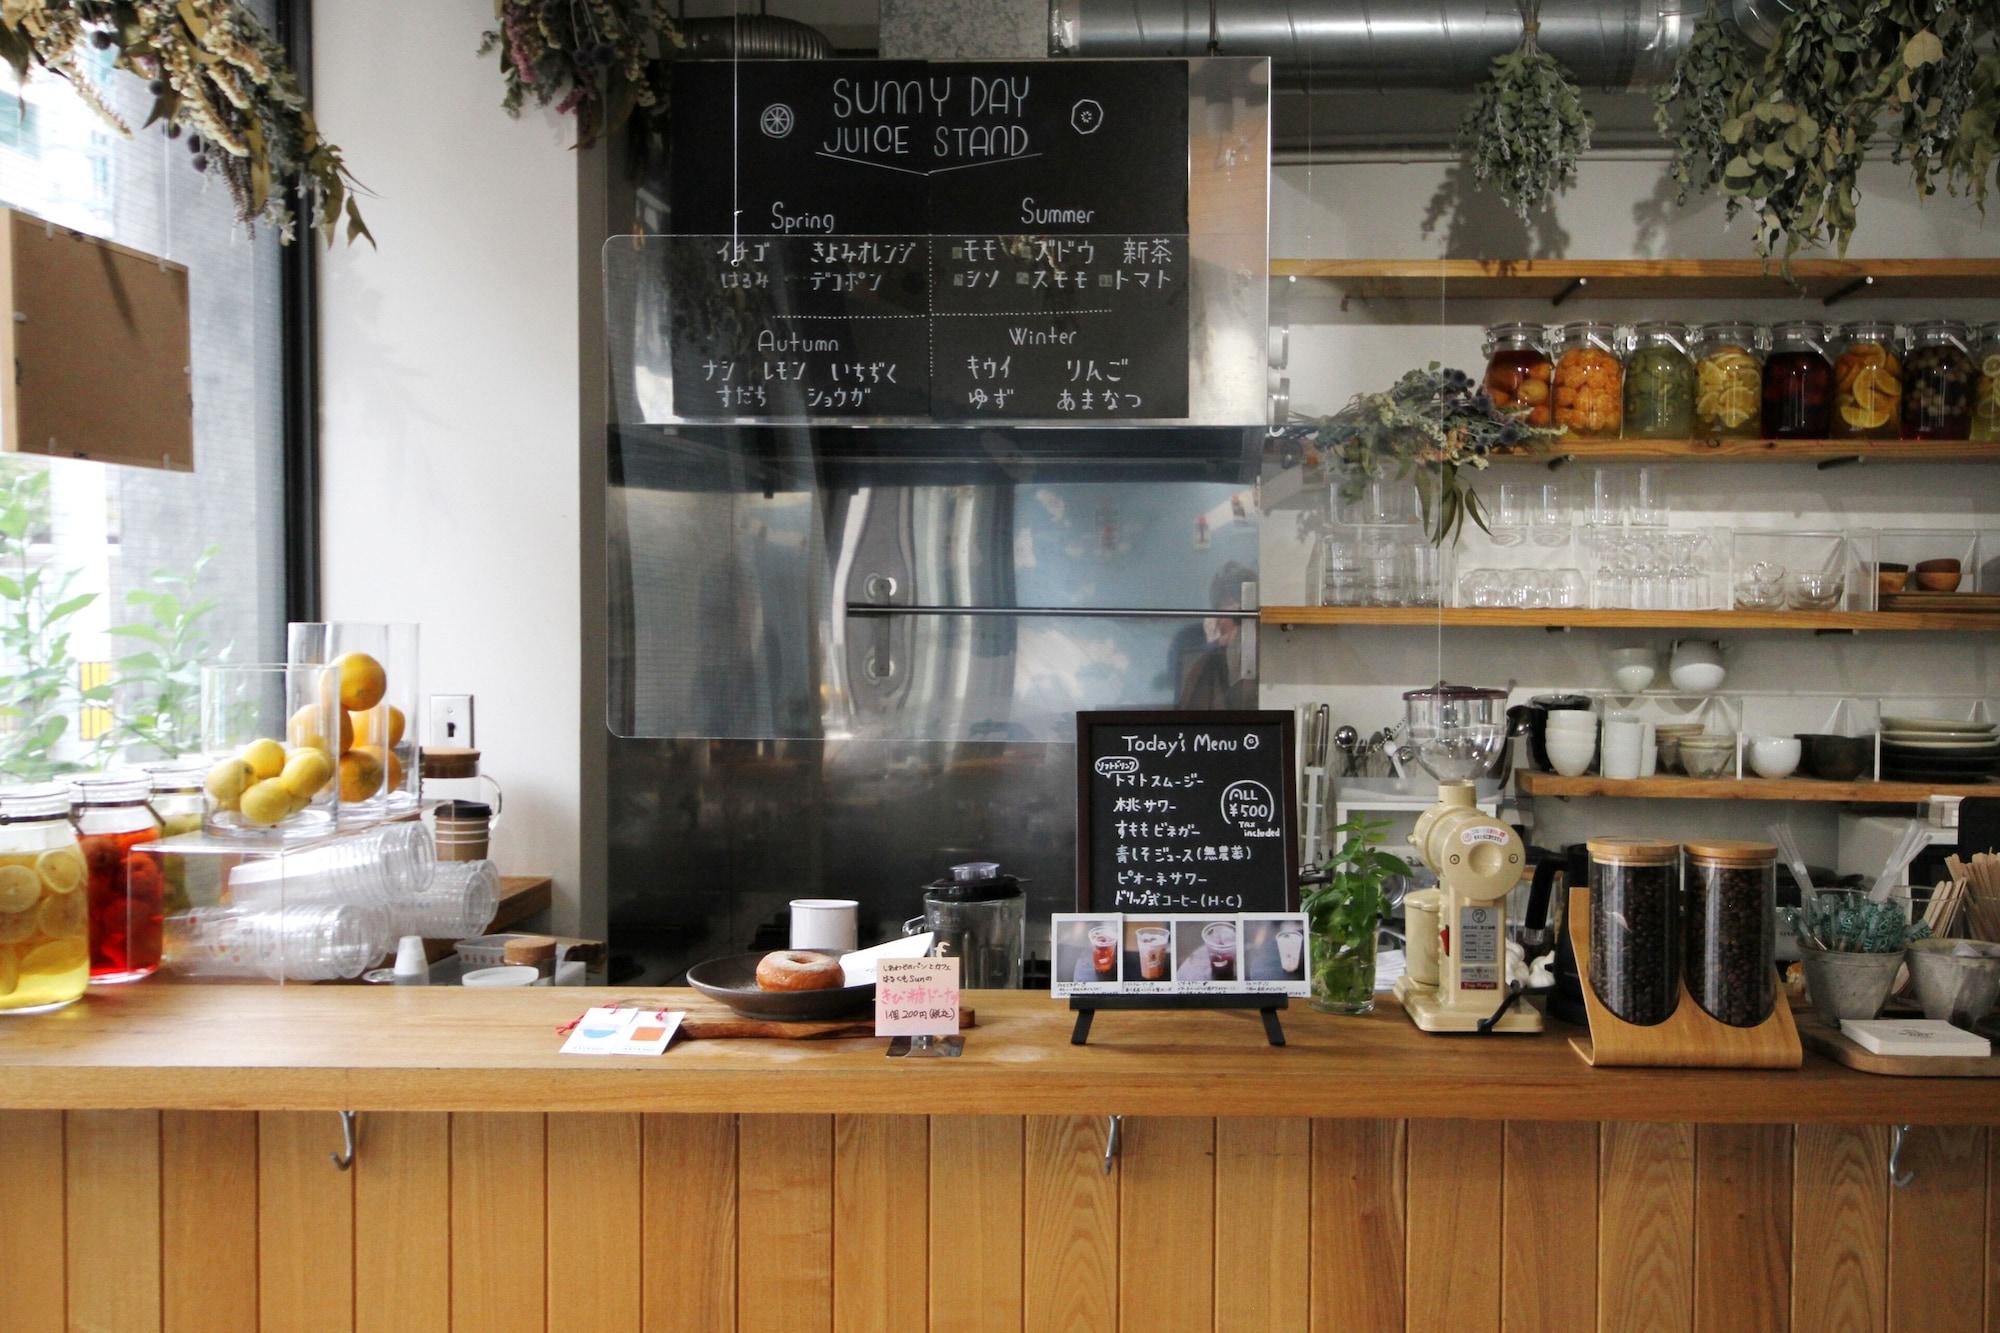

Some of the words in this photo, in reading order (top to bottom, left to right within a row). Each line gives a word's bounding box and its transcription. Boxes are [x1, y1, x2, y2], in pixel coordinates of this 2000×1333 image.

[834, 77, 951, 118] SUNNY
[971, 77, 1030, 118] DAY
[823, 126, 910, 155] JUICE
[934, 126, 1029, 156] STAND
[771, 201, 835, 234] Spring
[1021, 197, 1095, 225] Summer
[810, 241, 916, 264] きよみオレンジ
[964, 239, 997, 262] モモ
[1123, 237, 1172, 265] 新茶
[720, 271, 769, 289] はるみ
[810, 271, 882, 291] デコポン
[967, 270, 1000, 289] シソ
[1031, 270, 1088, 289] スモモ
[1115, 269, 1172, 290] トマト
[758, 329, 839, 352] Autumn
[1008, 326, 1077, 346] Winter
[702, 359, 736, 382] ナシ
[763, 361, 806, 381] レモン
[967, 355, 1012, 380] キウイ
[1066, 358, 1129, 382] りんご
[715, 384, 767, 408] すだち
[808, 387, 871, 407] ショウガ
[968, 388, 1014, 410] ゆず
[1056, 388, 1142, 411] あまなつ
[1121, 732, 1186, 758] Today's
[1193, 733, 1238, 752] Menu
[1116, 772, 1205, 788] トマトスムージー
[1229, 788, 1259, 801] ALL
[1229, 803, 1269, 818] ¥500
[1244, 827, 1281, 838] included
[1117, 869, 1208, 887] ピオーネサワー
